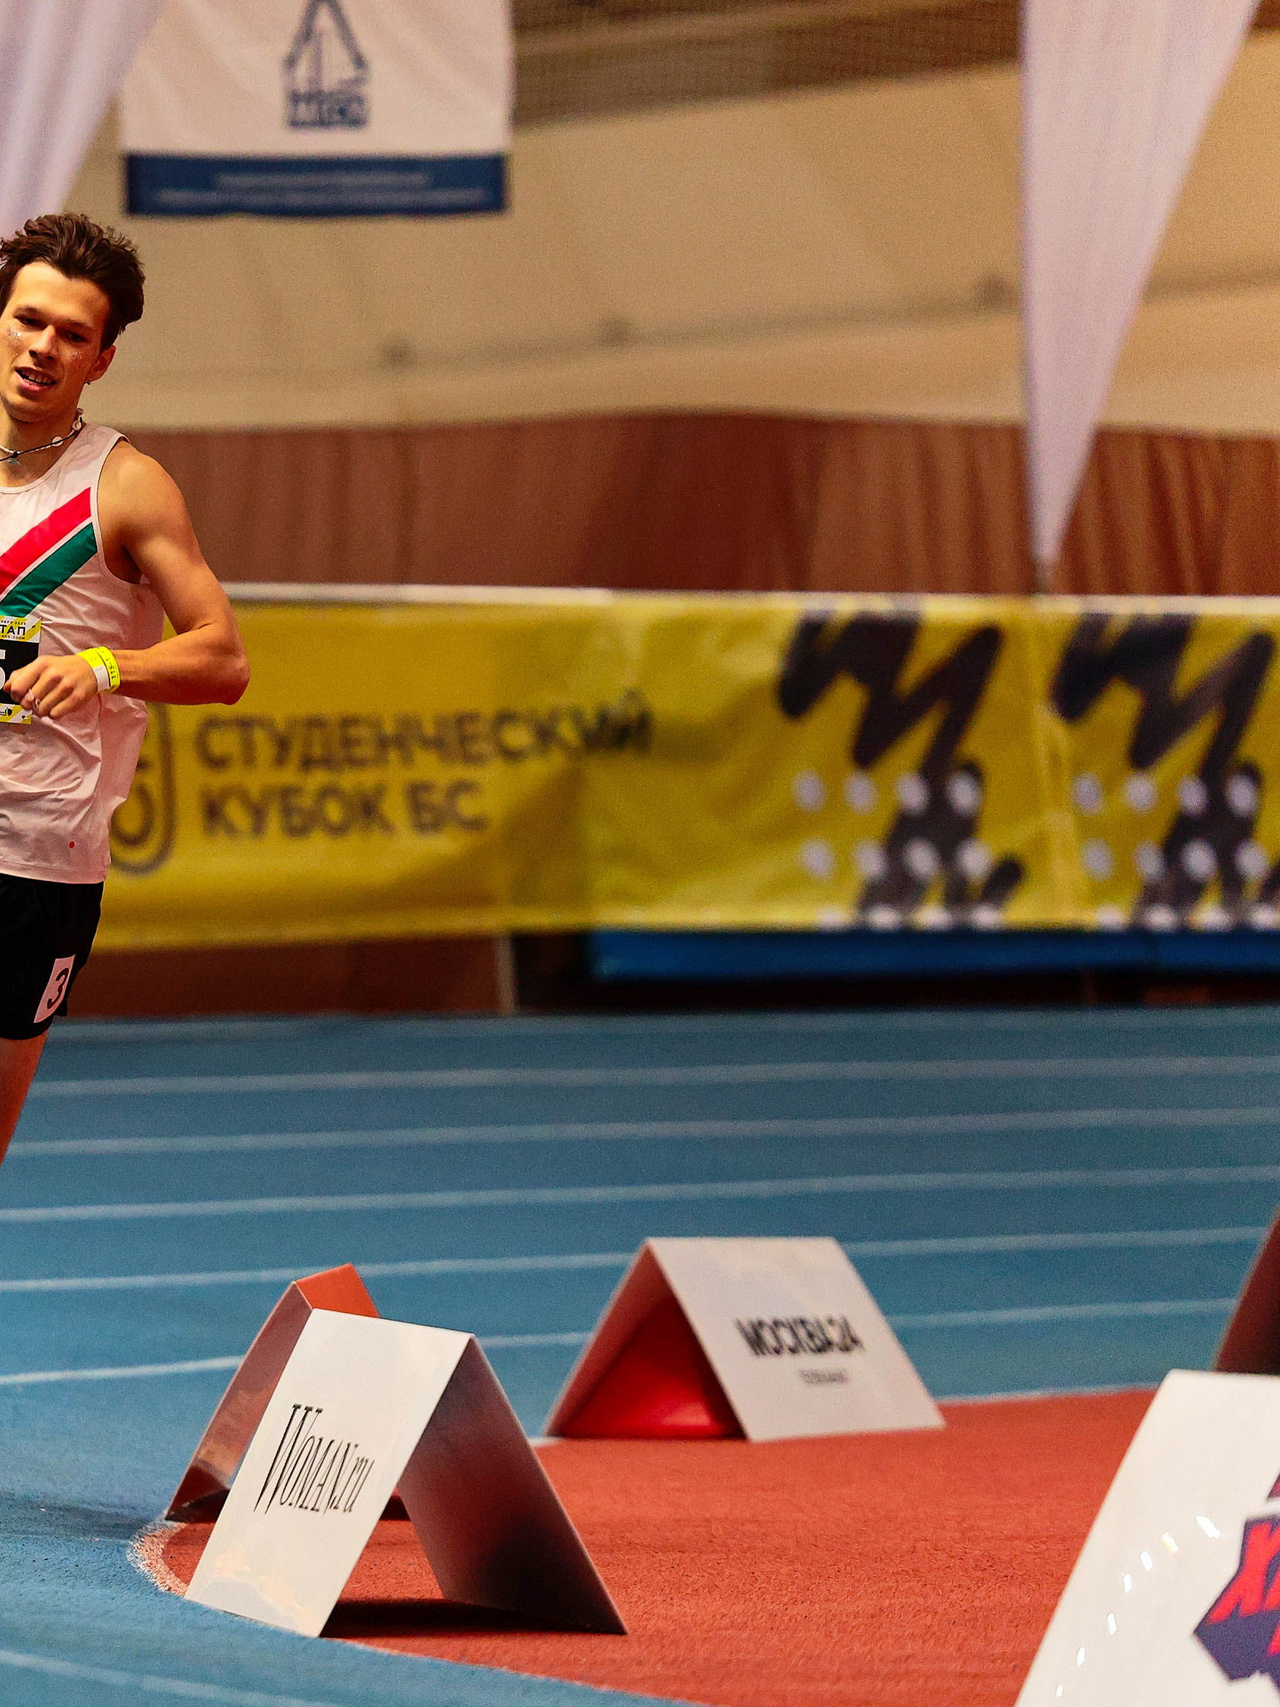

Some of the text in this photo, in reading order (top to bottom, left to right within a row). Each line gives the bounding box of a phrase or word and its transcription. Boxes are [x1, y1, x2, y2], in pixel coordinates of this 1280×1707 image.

[194, 689, 652, 773] СТУДЕНЧЕСКИЙ
[200, 780, 394, 840] КУБОК
[404, 776, 488, 836] БС
[47, 967, 69, 1010] 3
